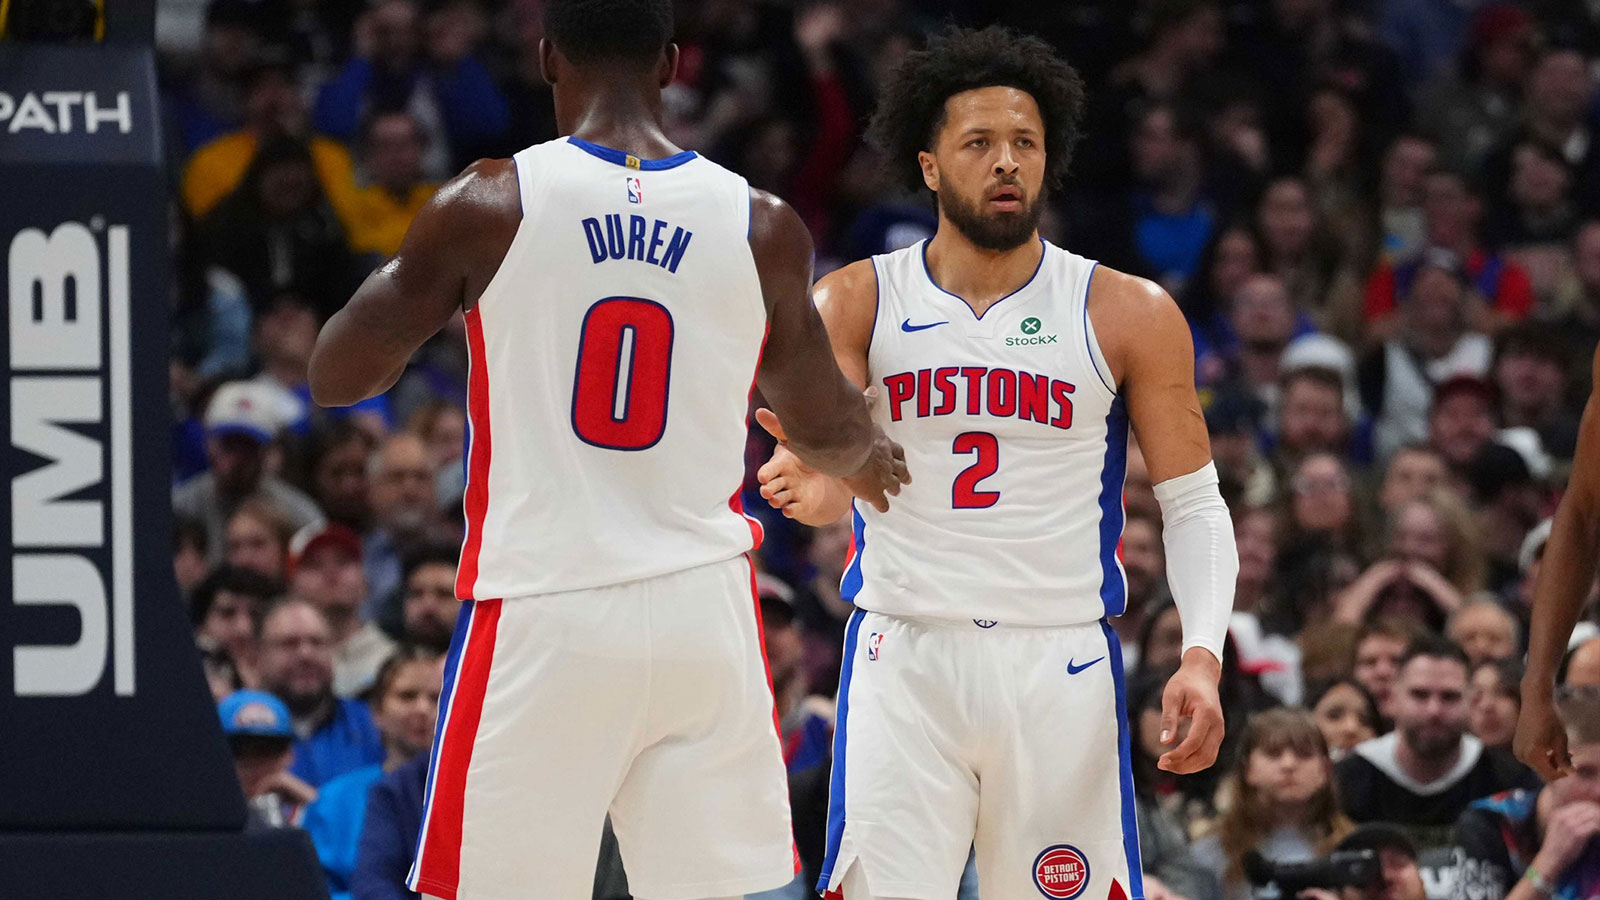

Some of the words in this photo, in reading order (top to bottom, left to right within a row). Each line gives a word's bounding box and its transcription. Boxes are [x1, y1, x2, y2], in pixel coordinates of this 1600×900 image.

[581, 213, 693, 274] DUREN
[1005, 334, 1057, 346] StockX
[570, 295, 675, 452] 0
[883, 366, 1076, 430] PISTONS
[8, 221, 108, 697] UMB
[952, 431, 1001, 510] 2
[1043, 862, 1078, 874] DETROIT
[1044, 872, 1079, 883] PISTONS
